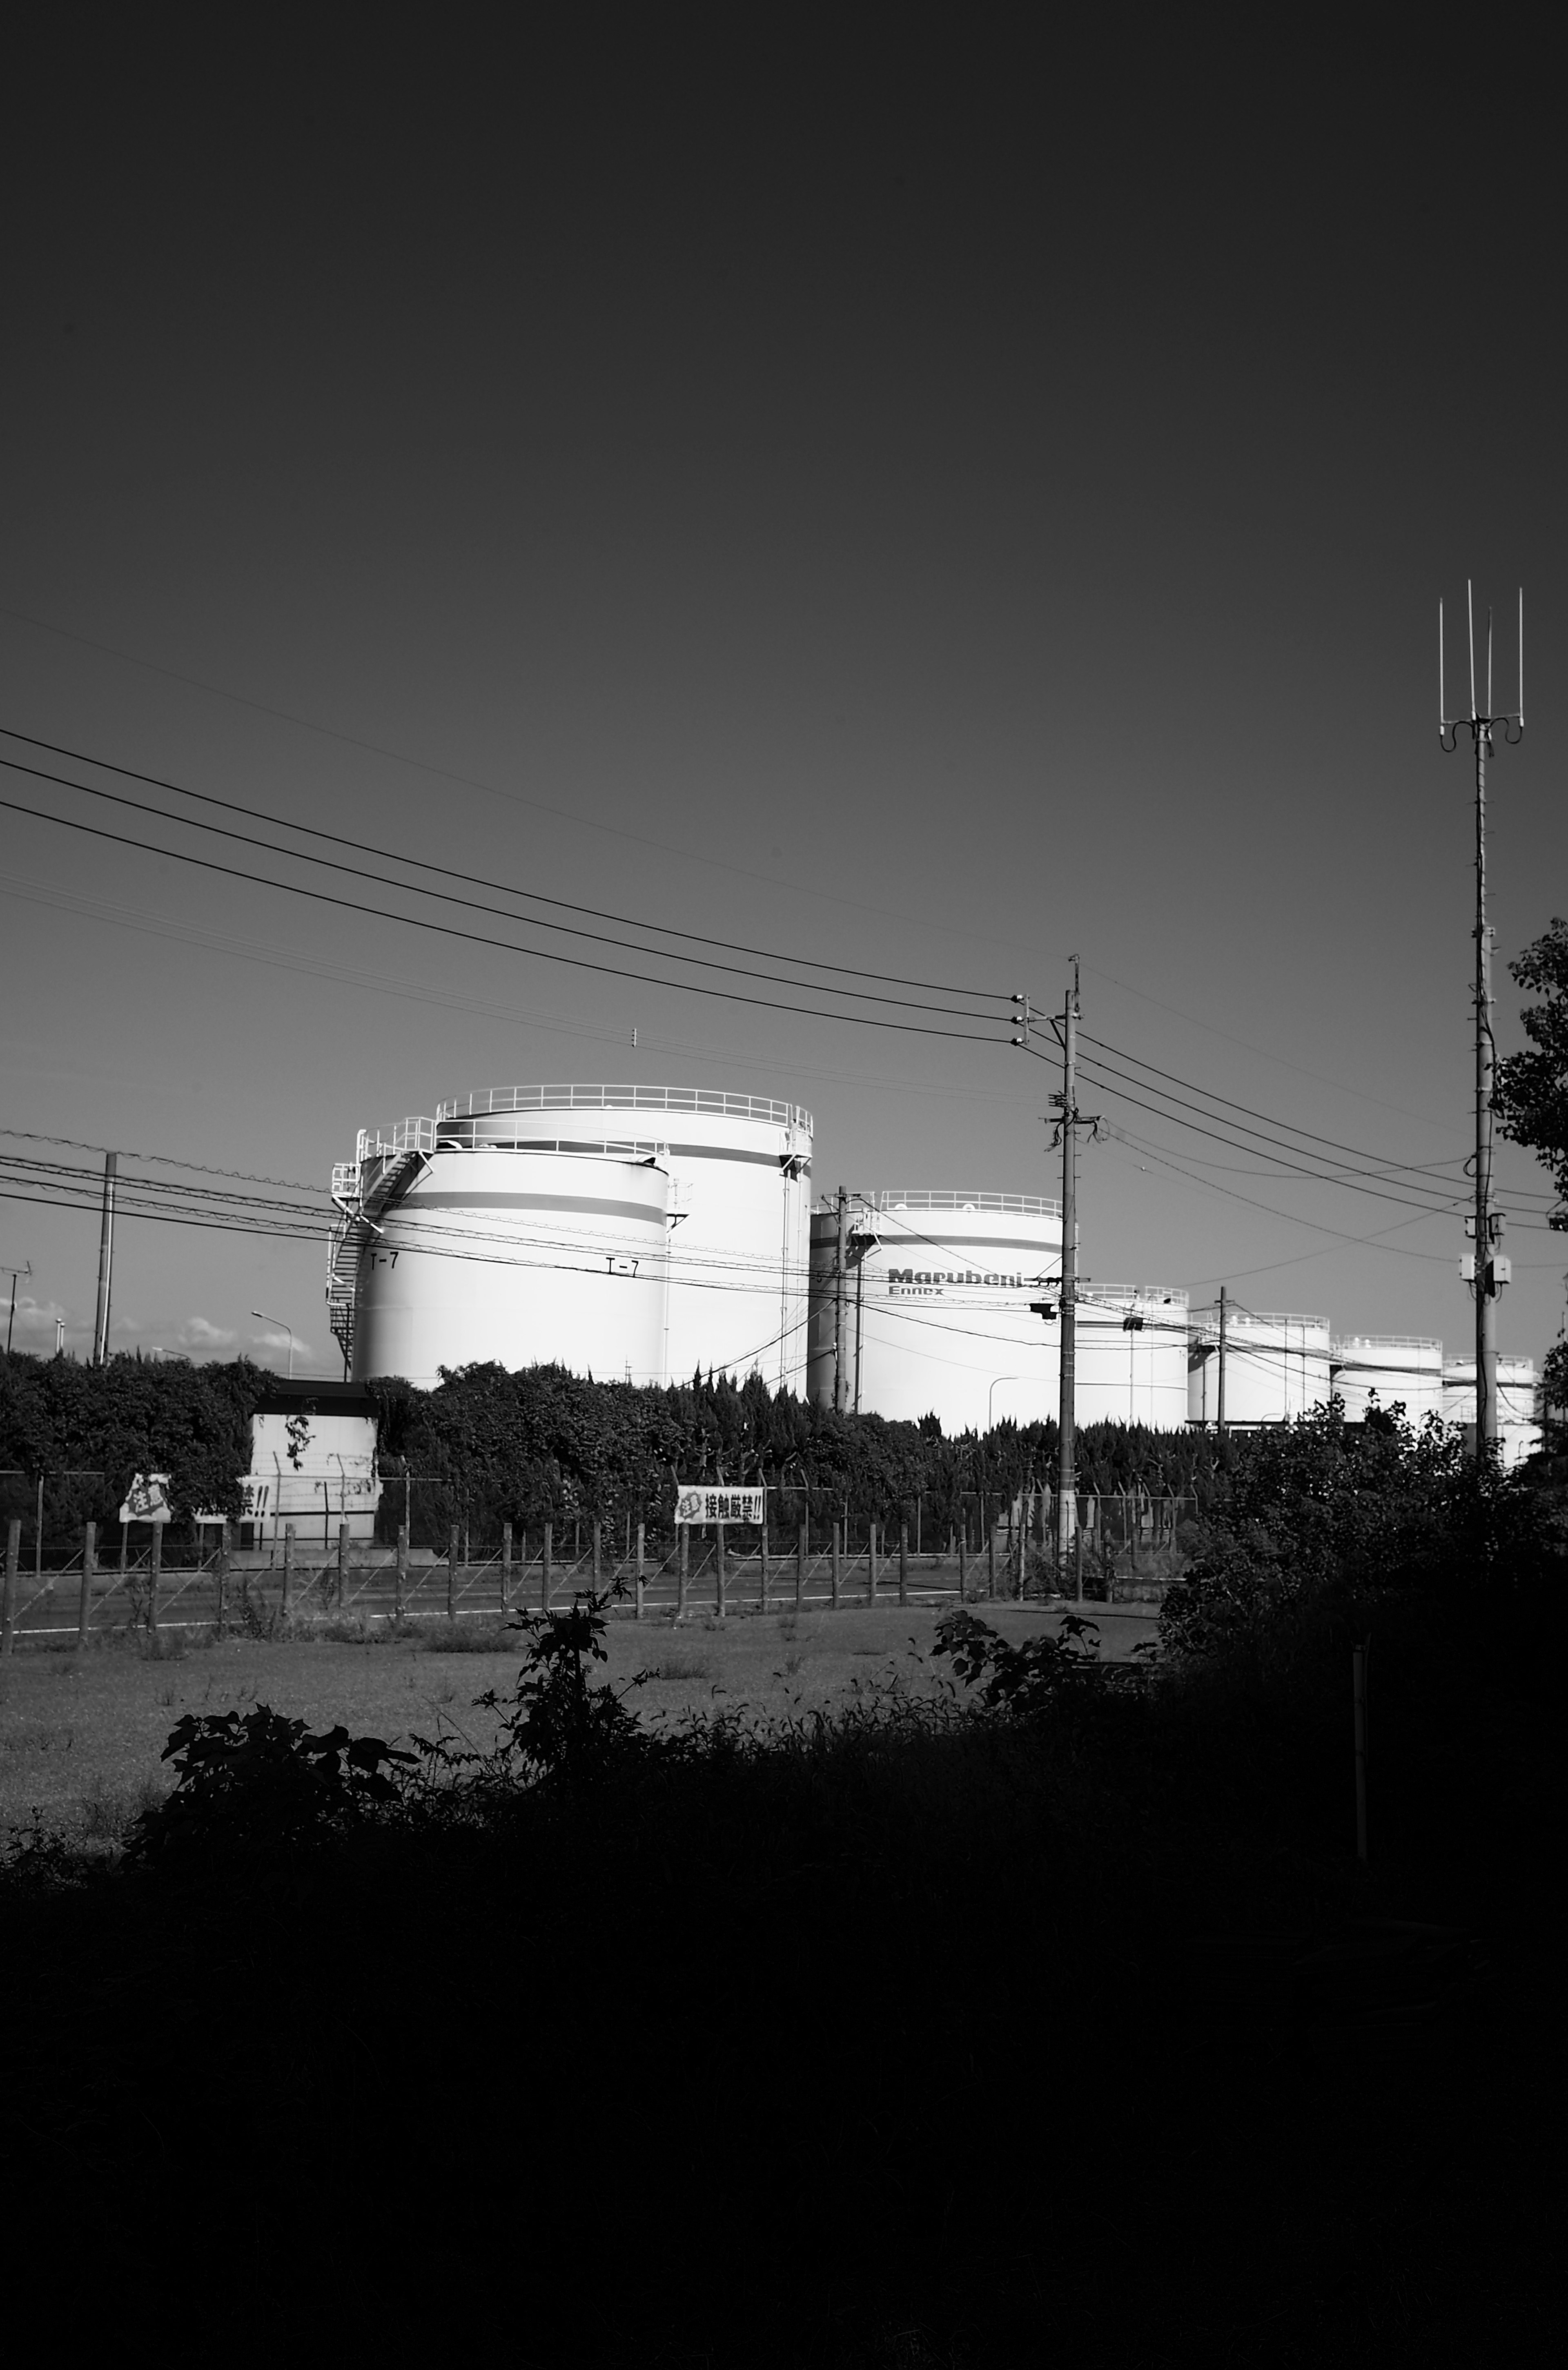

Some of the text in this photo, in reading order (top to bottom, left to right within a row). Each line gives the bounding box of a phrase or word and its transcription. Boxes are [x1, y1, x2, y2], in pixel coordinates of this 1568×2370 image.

[370, 1252, 399, 1270] T-7
[606, 1257, 639, 1278] T-7
[889, 1269, 1022, 1287] Marubeni
[889, 1286, 944, 1295] Ennex
